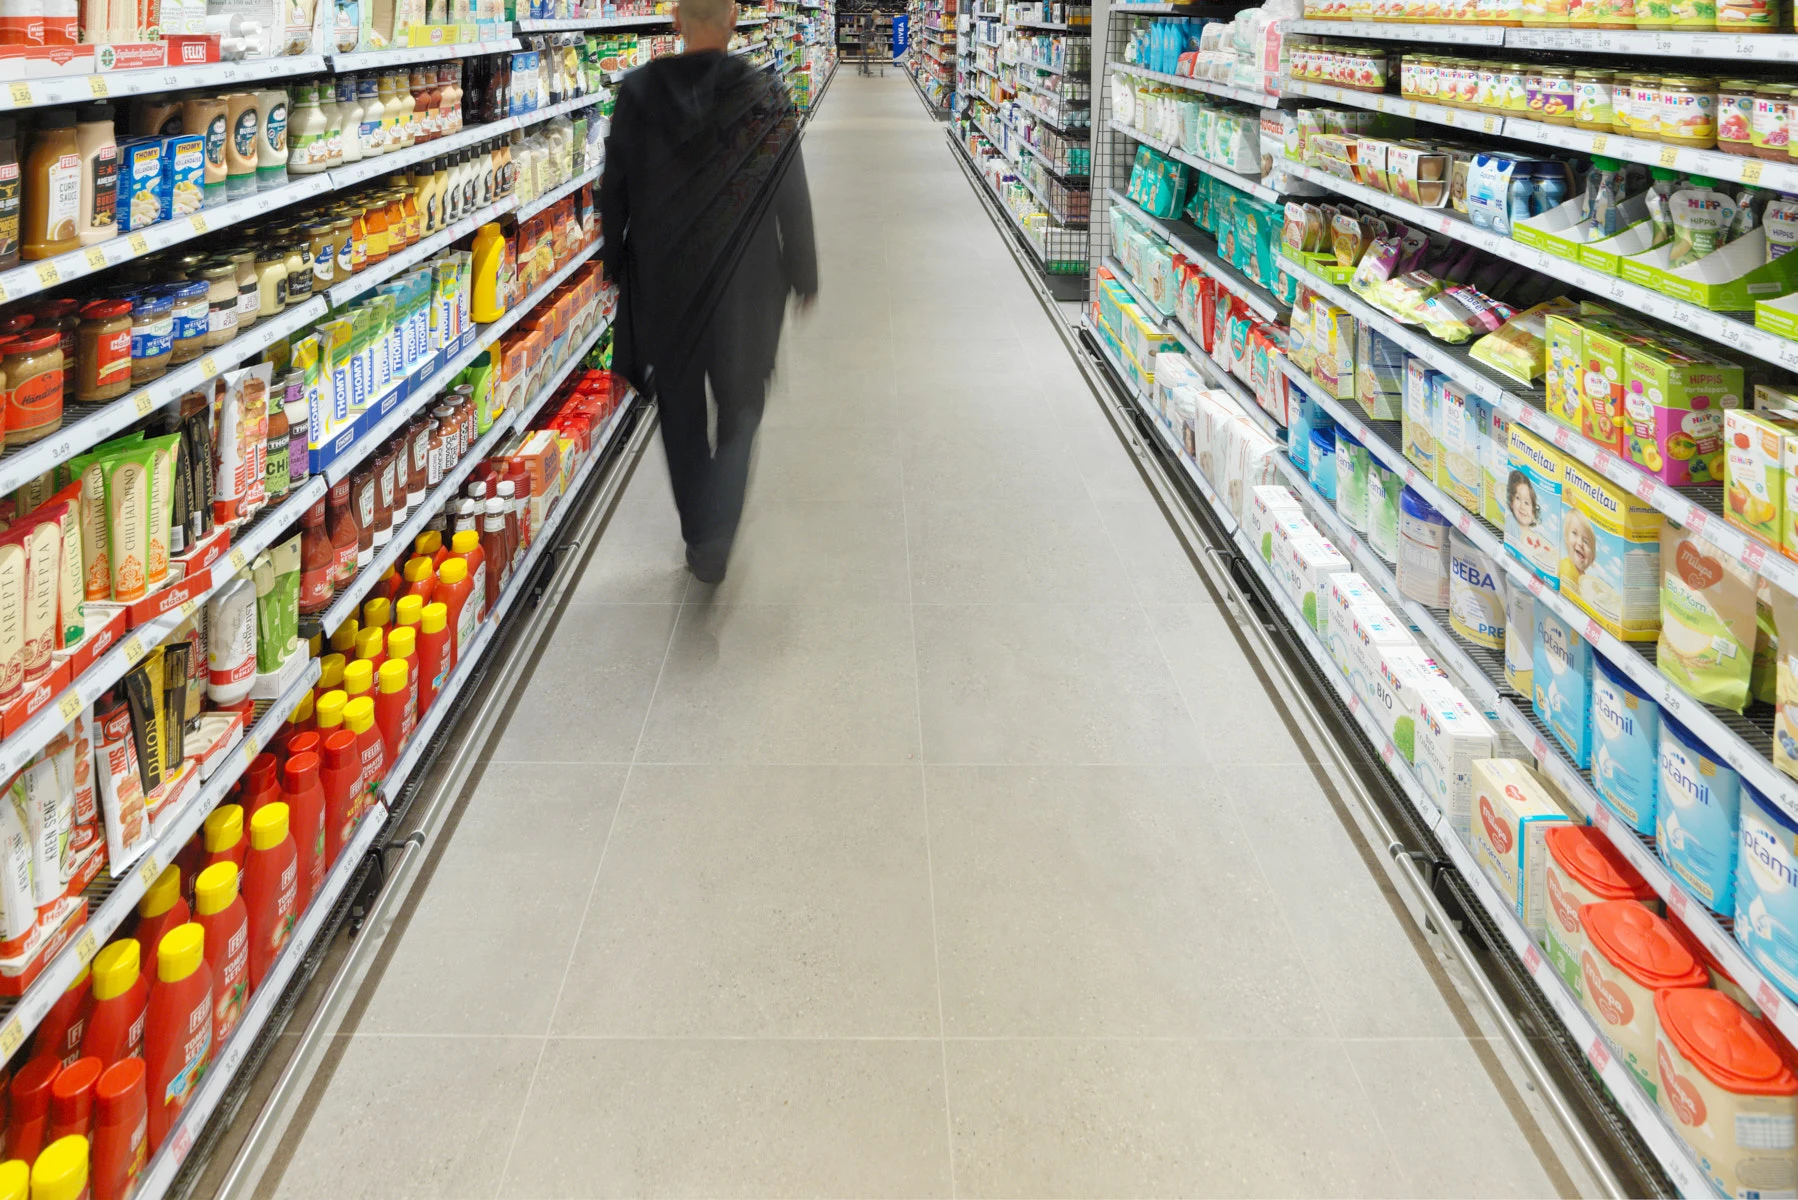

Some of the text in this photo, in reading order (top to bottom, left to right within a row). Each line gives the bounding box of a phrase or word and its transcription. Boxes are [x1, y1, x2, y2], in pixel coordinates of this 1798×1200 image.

[184, 44, 204, 60] FELIX
[897, 22, 905, 44] NIVEA
[1665, 95, 1694, 106] HiPP
[1688, 199, 1721, 210] HiPP
[335, 370, 346, 420] THOMY
[1511, 432, 1556, 473] Himmeltau
[1565, 466, 1617, 512] Himmeltau
[38, 542, 50, 621] SAREPTA
[1452, 555, 1496, 590] BEBA
[3, 564, 15, 645] SAREPTA
[1593, 690, 1634, 736] ptamil
[146, 718, 160, 777] DIJON
[1659, 752, 1710, 806] ptamil
